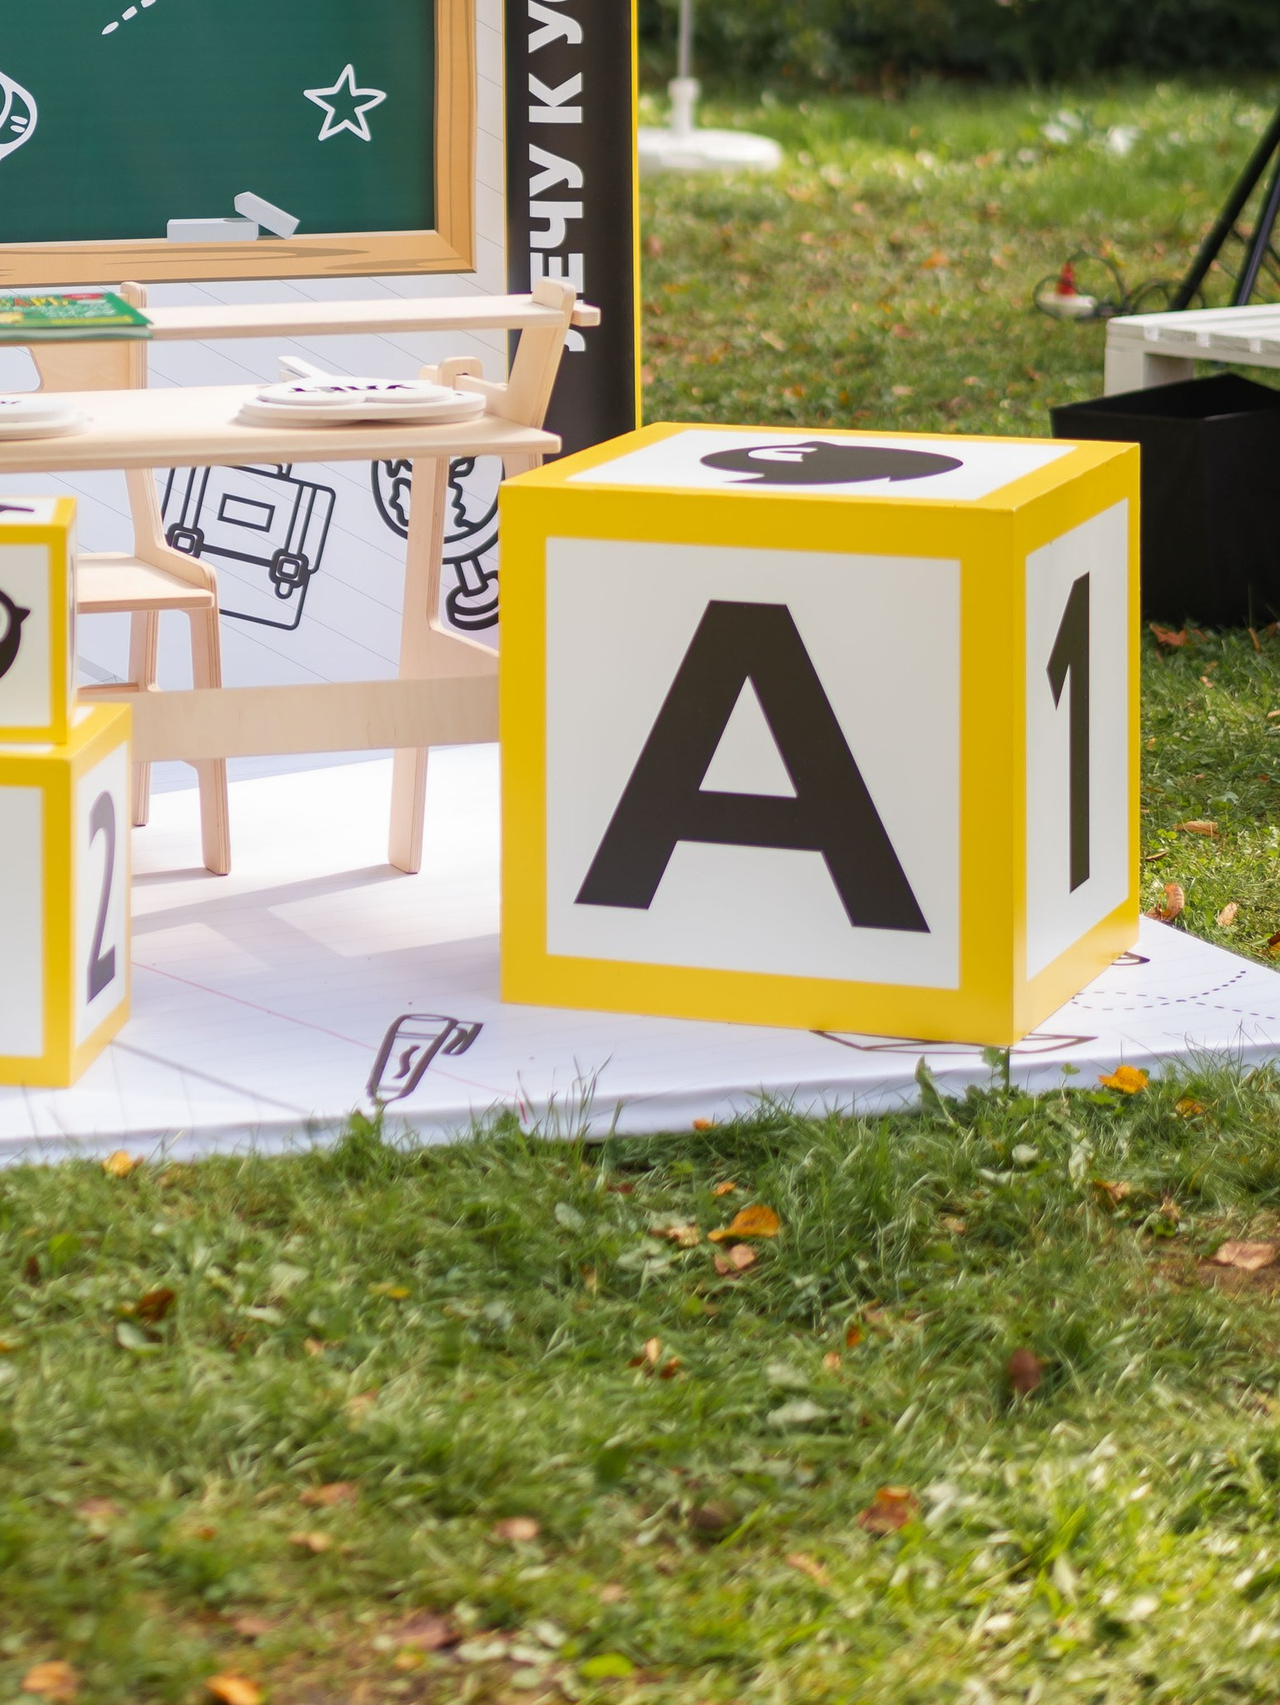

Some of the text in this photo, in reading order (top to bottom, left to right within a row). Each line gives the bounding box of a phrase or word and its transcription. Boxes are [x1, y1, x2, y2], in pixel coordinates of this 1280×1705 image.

[528, 71, 583, 124] К
[529, 143, 586, 352] ЕЧУ
[574, 599, 931, 933] А
[1046, 570, 1090, 895] 1
[86, 790, 117, 1006] 2
